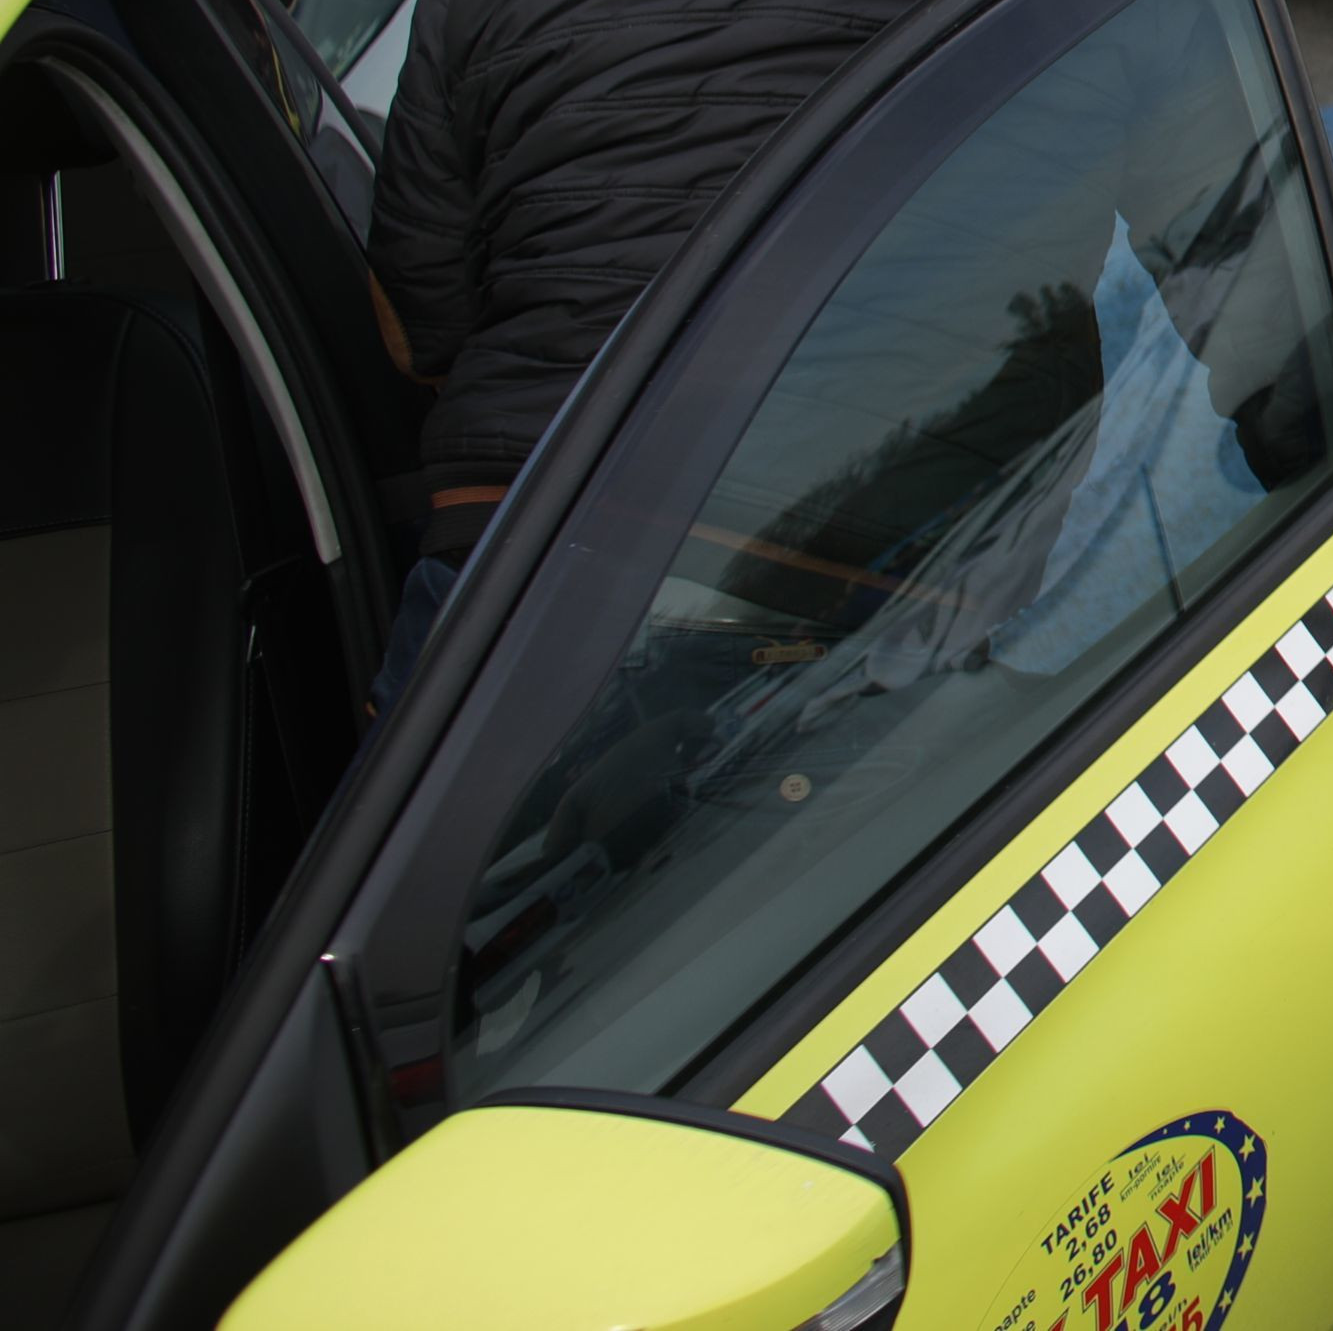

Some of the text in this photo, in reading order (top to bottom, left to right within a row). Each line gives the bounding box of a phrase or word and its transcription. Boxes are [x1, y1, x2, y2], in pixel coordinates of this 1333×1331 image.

[1040, 1170, 1116, 1256] TARIFE
[1065, 1203, 1111, 1262] 2,68
[1081, 1143, 1217, 1331] TAXI
[1186, 1206, 1233, 1270] lei/km
[1059, 1228, 1118, 1303] 26,80
